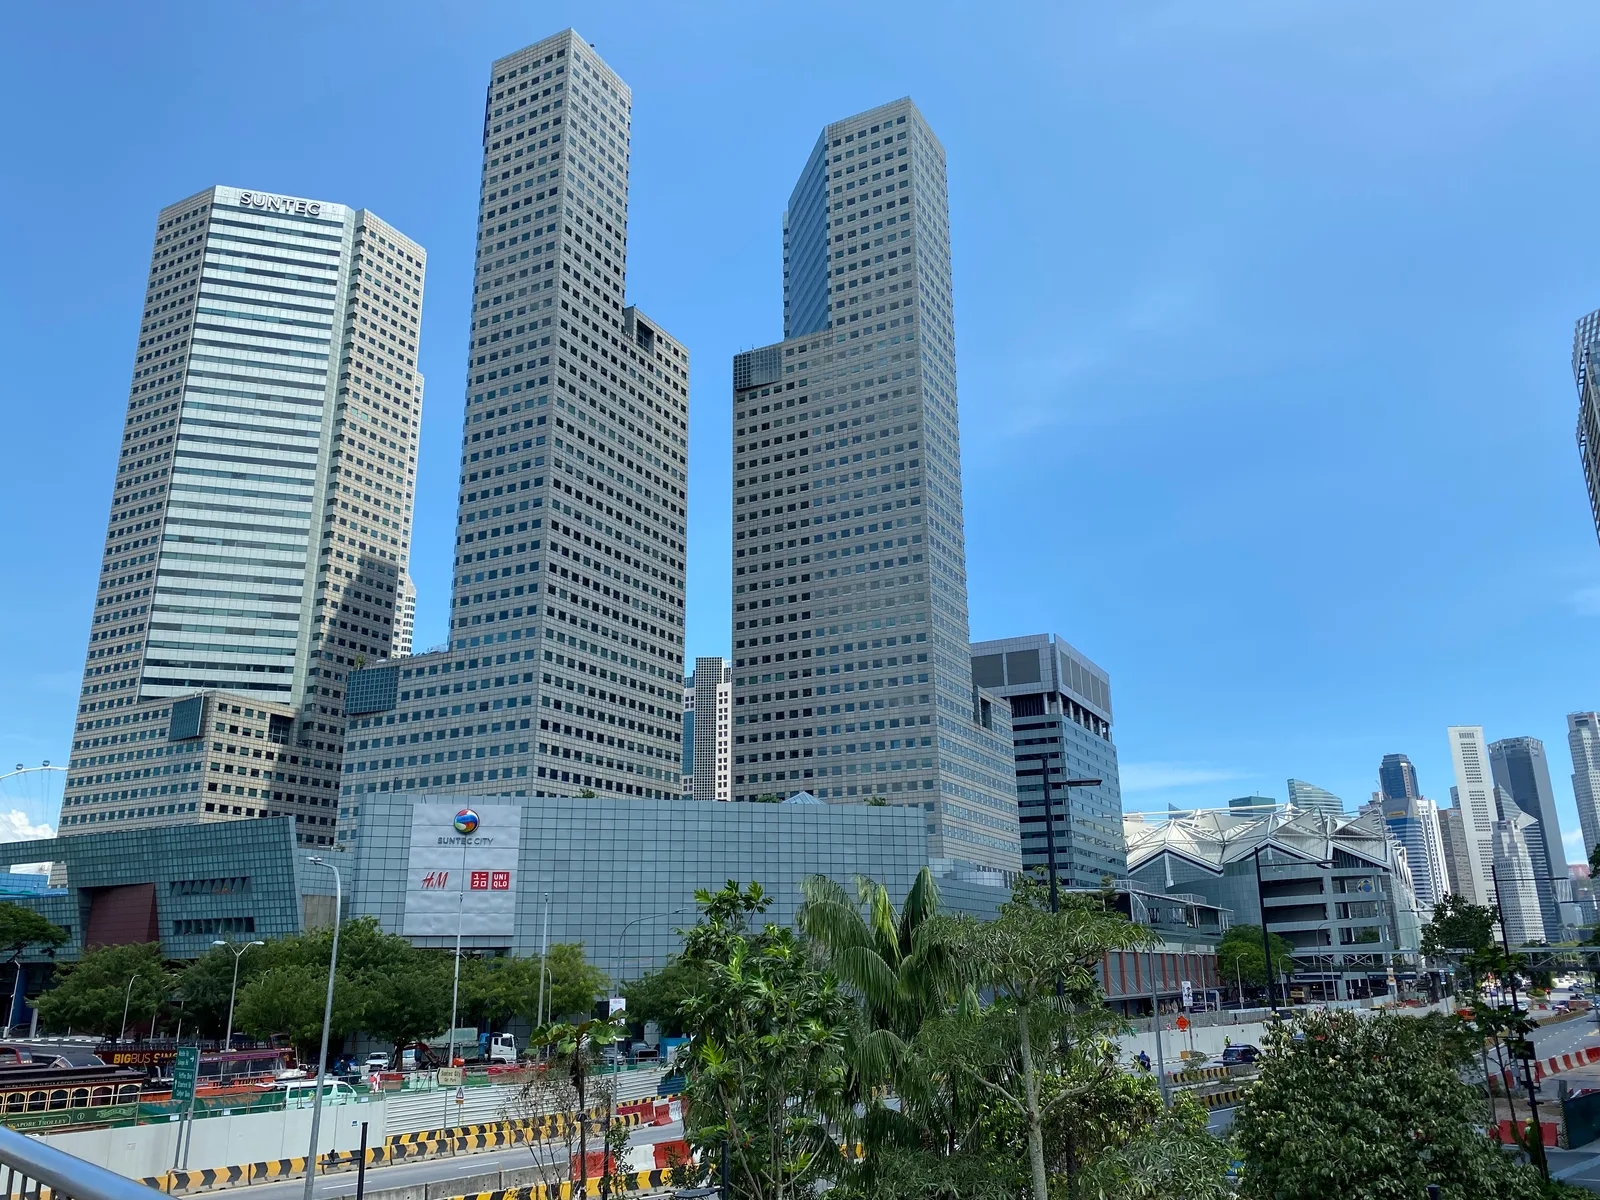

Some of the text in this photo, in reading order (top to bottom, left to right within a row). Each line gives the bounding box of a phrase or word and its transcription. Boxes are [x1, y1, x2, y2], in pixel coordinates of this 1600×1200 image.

[240, 191, 320, 216] SUNTEC
[437, 837, 494, 845] SUNTEC CITY
[421, 871, 449, 889] H&M
[493, 880, 508, 889] QLO
